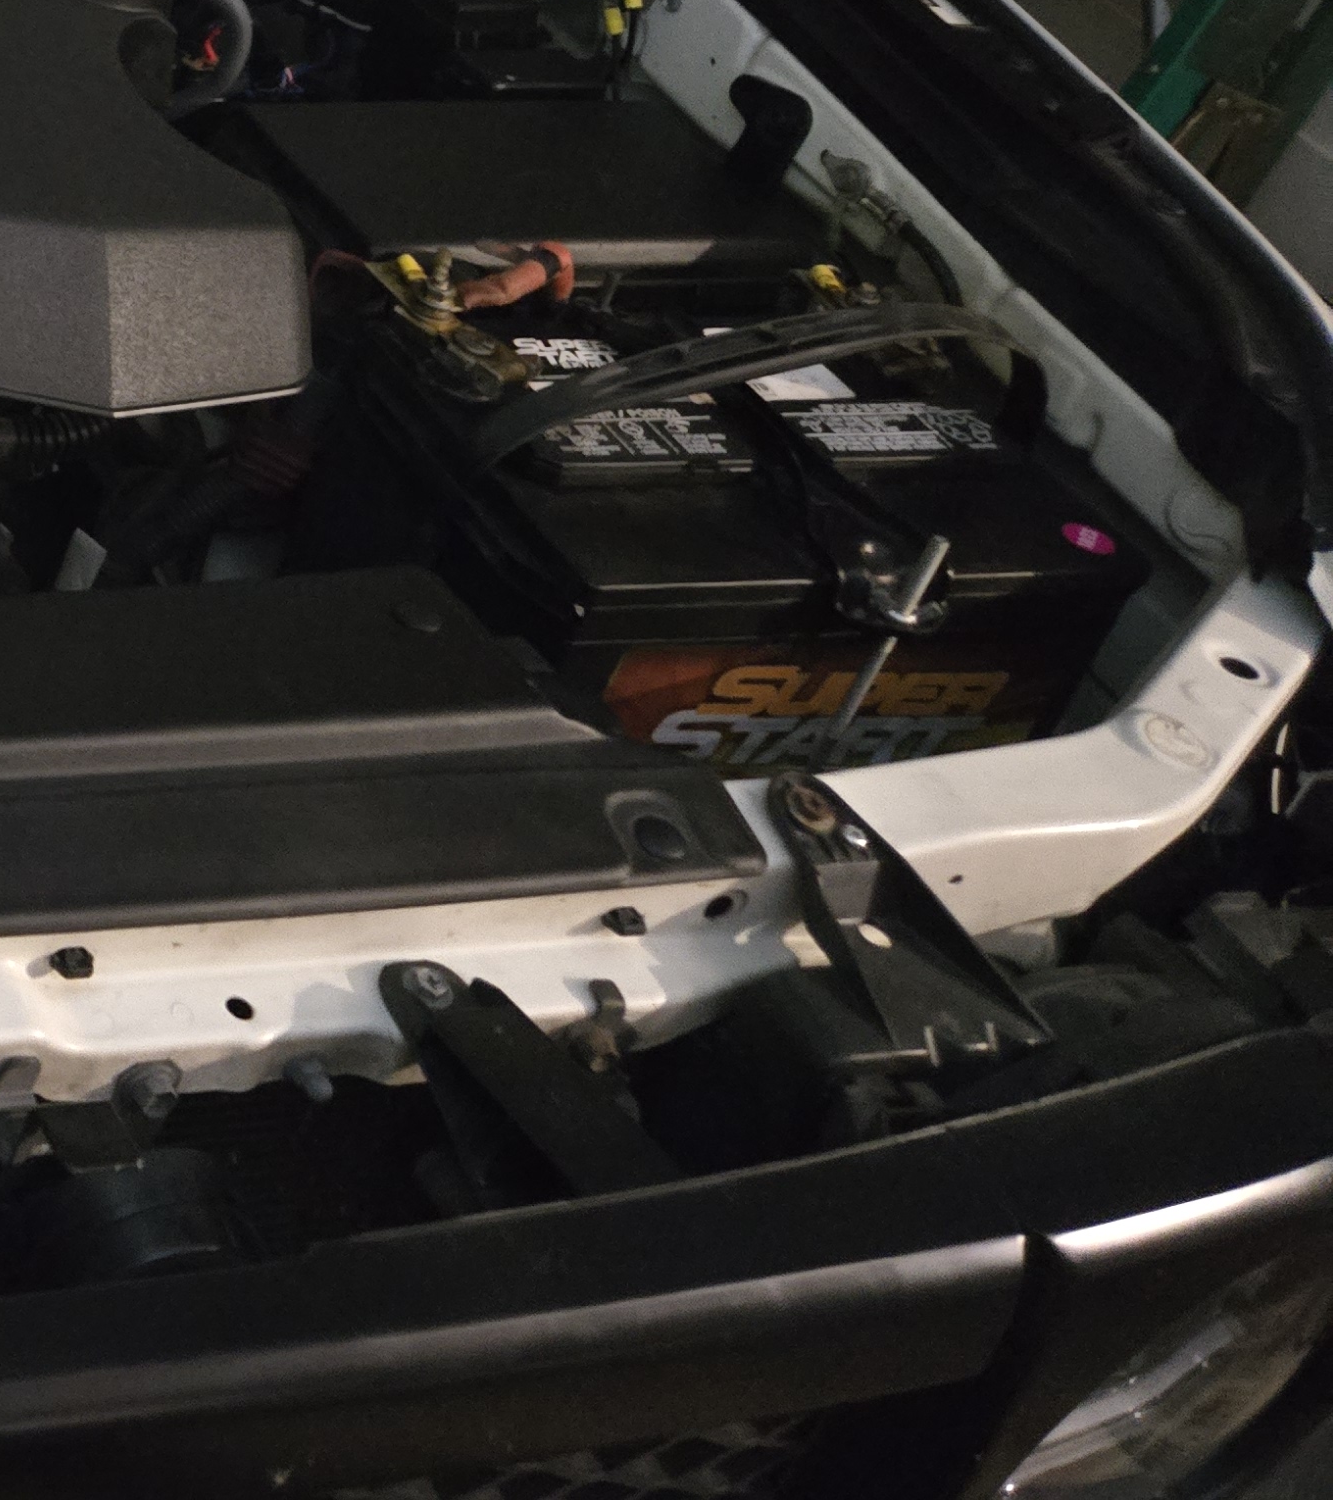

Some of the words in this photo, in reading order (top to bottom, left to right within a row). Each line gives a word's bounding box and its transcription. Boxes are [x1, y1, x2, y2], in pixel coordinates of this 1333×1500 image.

[513, 338, 615, 355] SUPER
[696, 665, 1011, 716] SUPER
[651, 710, 990, 765] START
